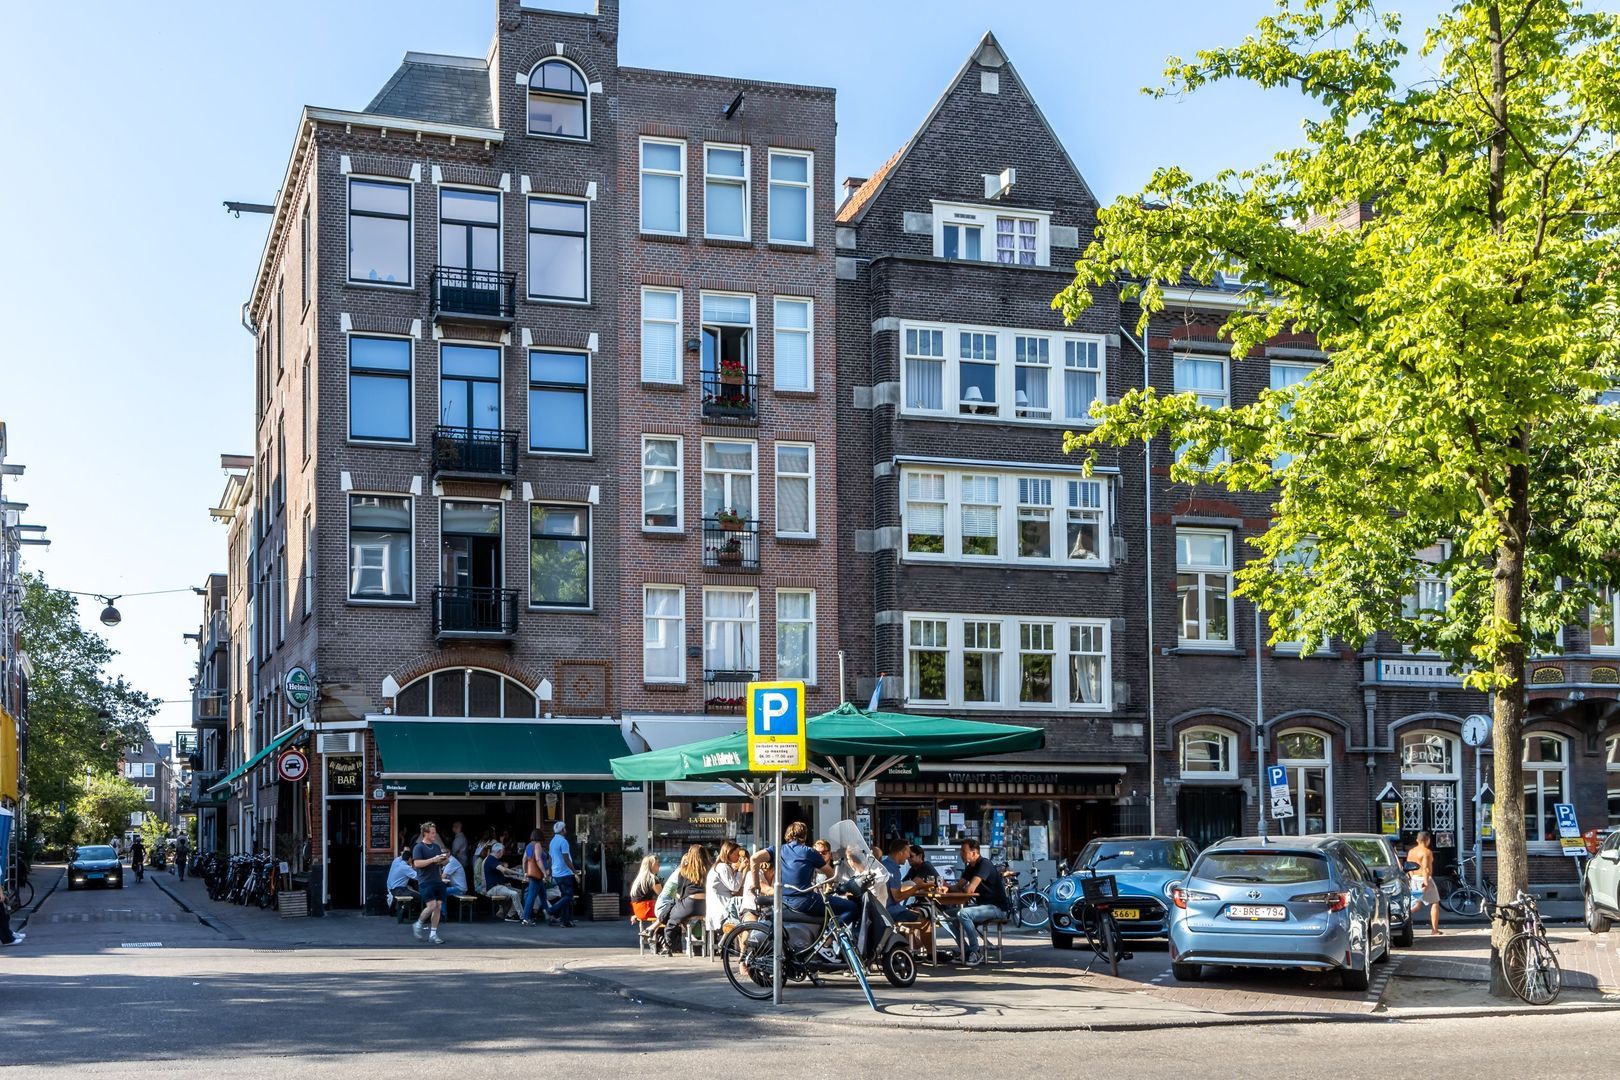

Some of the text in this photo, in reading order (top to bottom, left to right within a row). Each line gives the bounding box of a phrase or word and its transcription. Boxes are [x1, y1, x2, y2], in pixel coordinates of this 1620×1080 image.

[1384, 664, 1474, 676] Pianolam
[763, 692, 789, 731] P
[337, 776, 356, 784] BAR
[948, 772, 1058, 784] VIVANT DE JORDAAN
[1272, 768, 1282, 784] P
[1559, 806, 1570, 818] P
